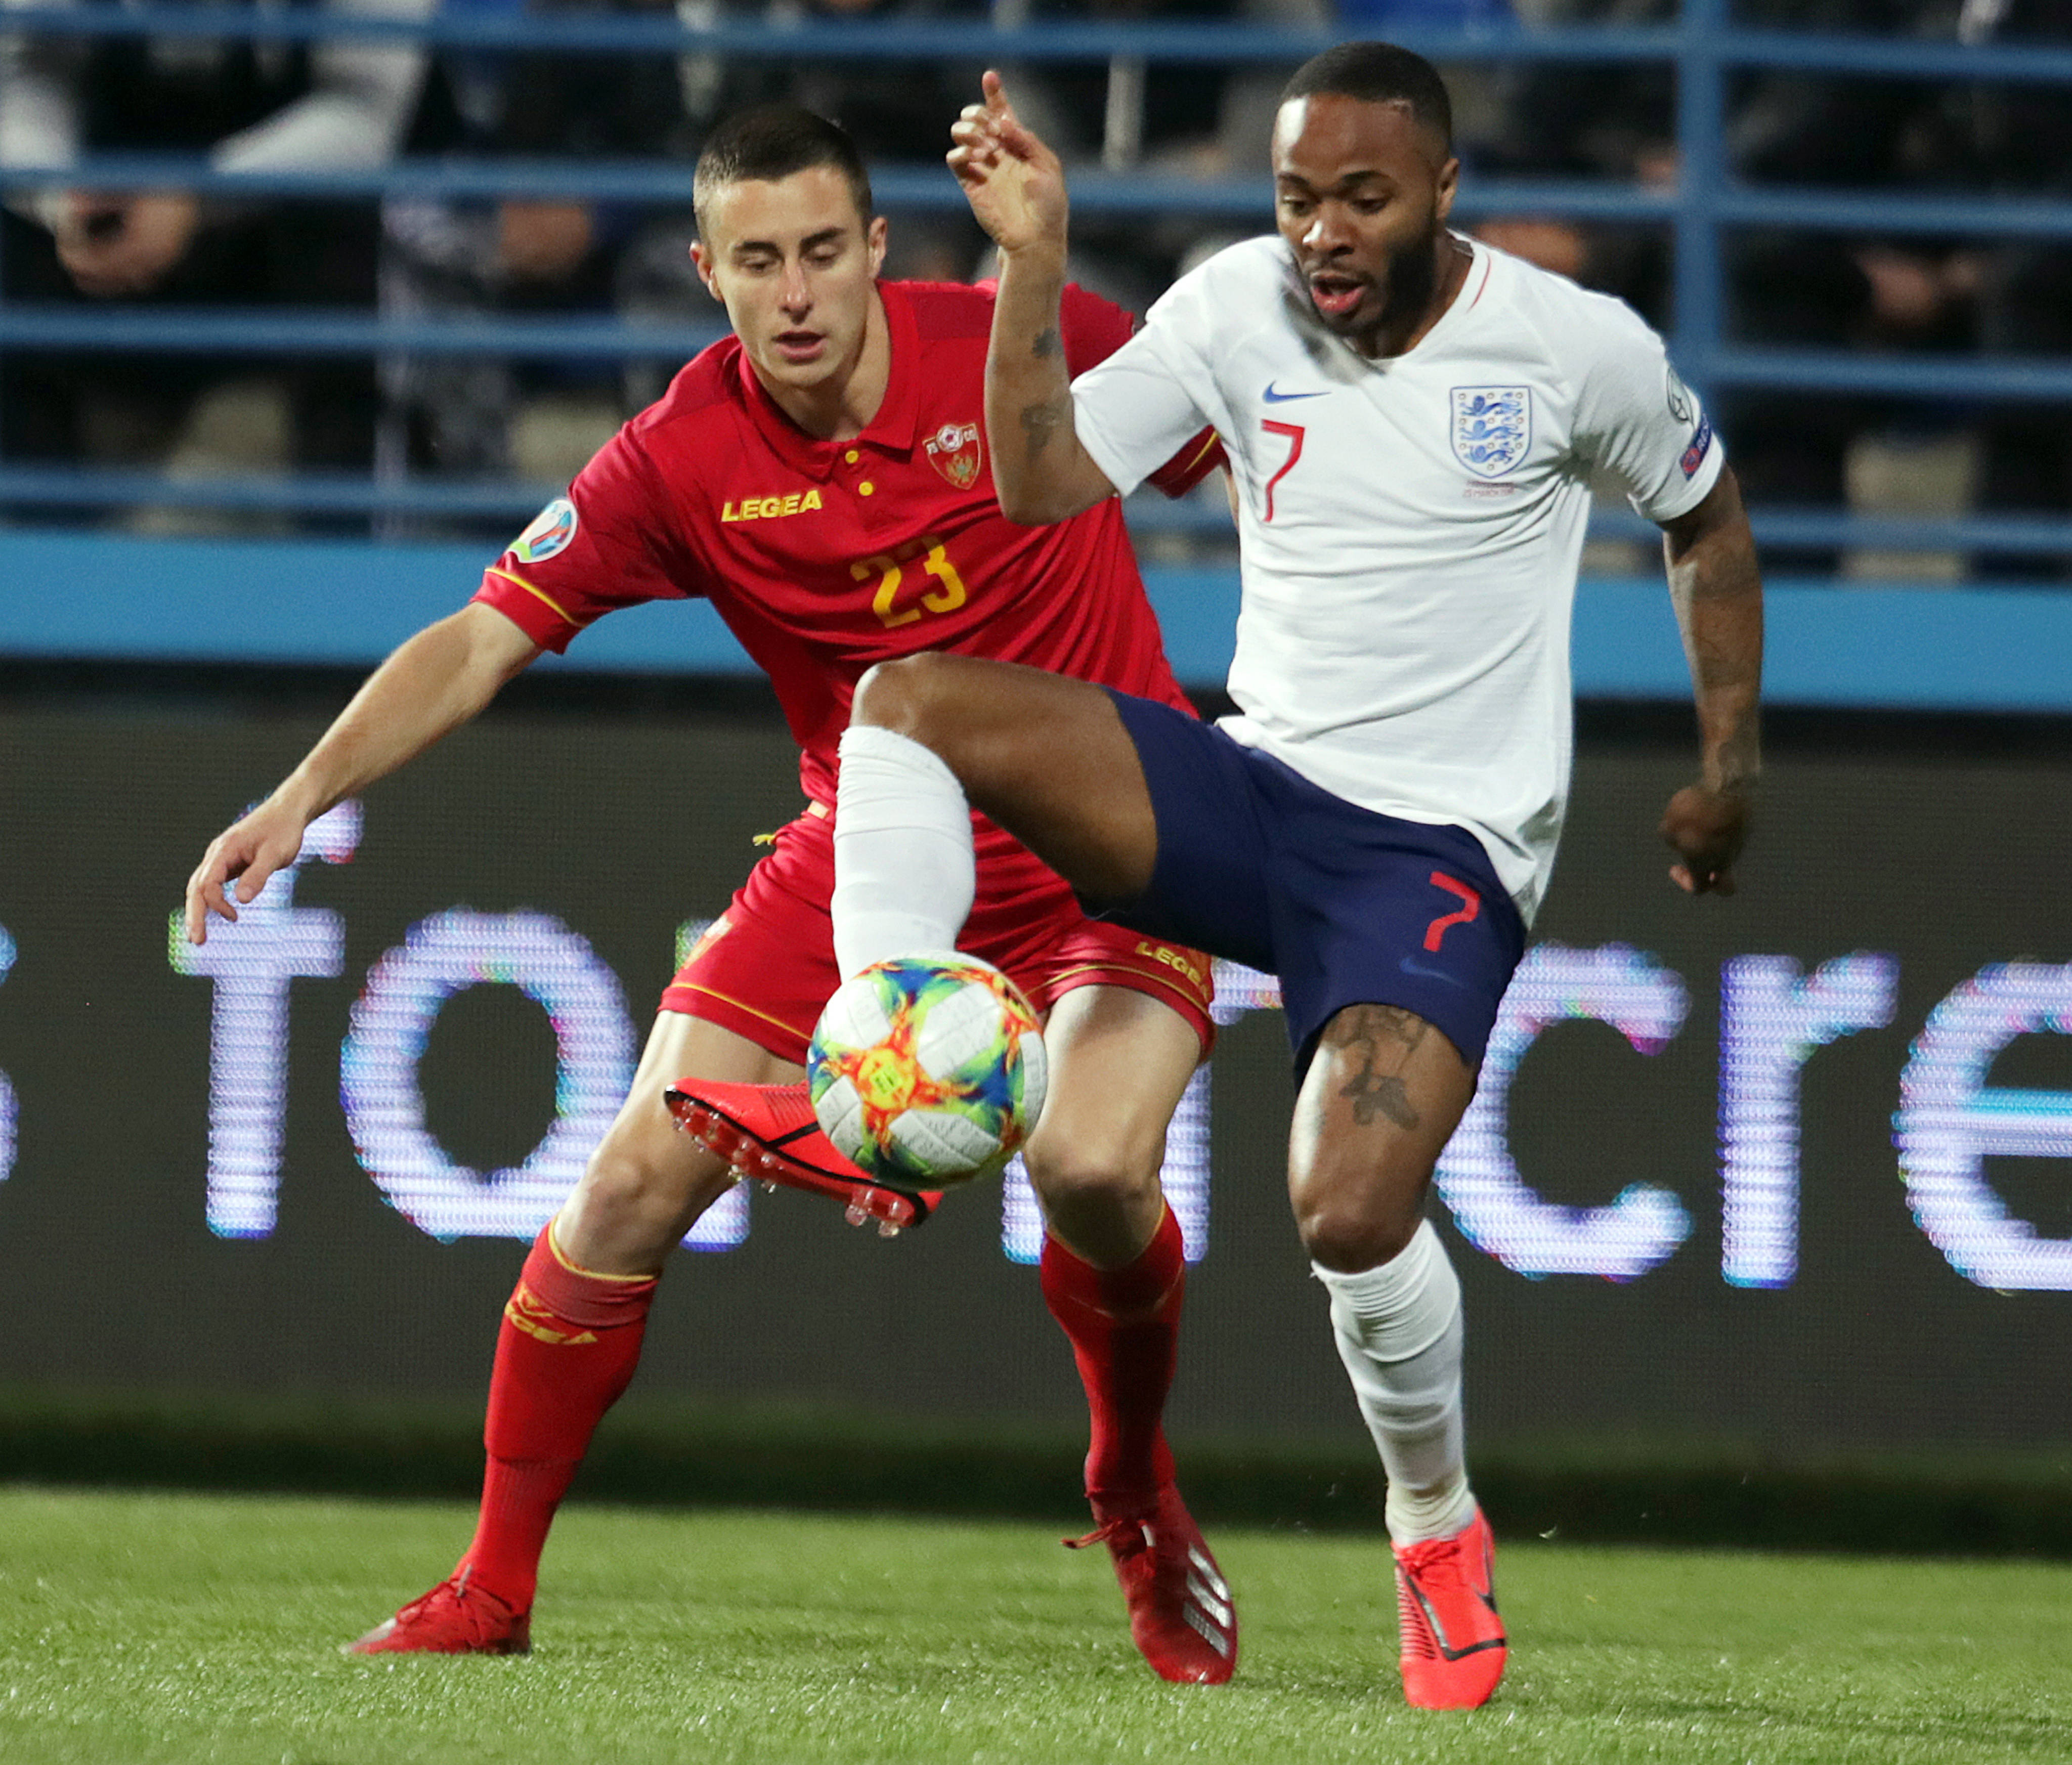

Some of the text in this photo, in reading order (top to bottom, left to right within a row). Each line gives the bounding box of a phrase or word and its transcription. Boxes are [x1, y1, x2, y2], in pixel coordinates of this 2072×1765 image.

[721, 490, 823, 522] LEGEA
[1261, 418, 1305, 523] 7
[850, 536, 966, 628] 23
[1423, 871, 1480, 952] 7
